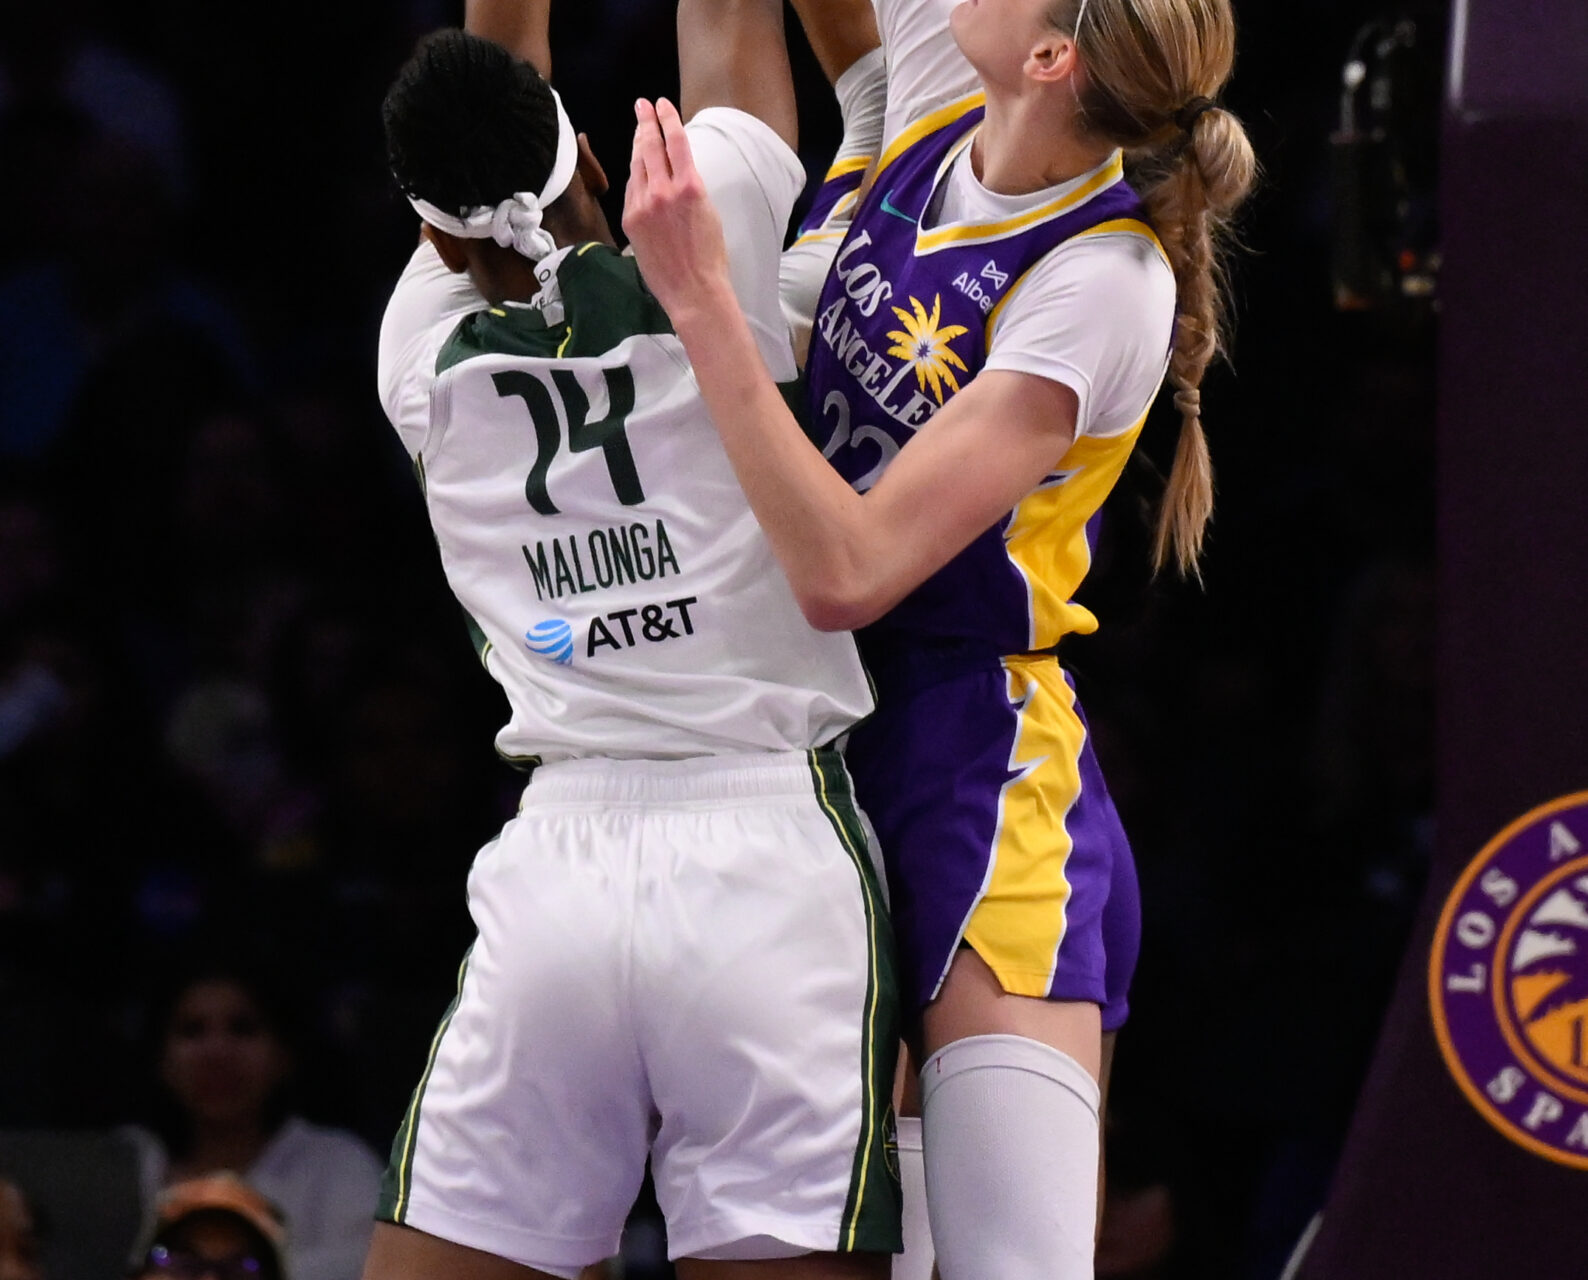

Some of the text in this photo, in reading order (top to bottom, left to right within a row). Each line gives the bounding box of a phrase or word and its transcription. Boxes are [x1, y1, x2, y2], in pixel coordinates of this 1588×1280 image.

[836, 230, 893, 318] LOS
[819, 297, 941, 431] ANGELE
[491, 364, 646, 515] 14
[522, 519, 681, 601] MALONGA
[587, 597, 698, 658] AT&T
[1447, 867, 1519, 993] LOS
[1487, 1066, 1588, 1150] SPA
